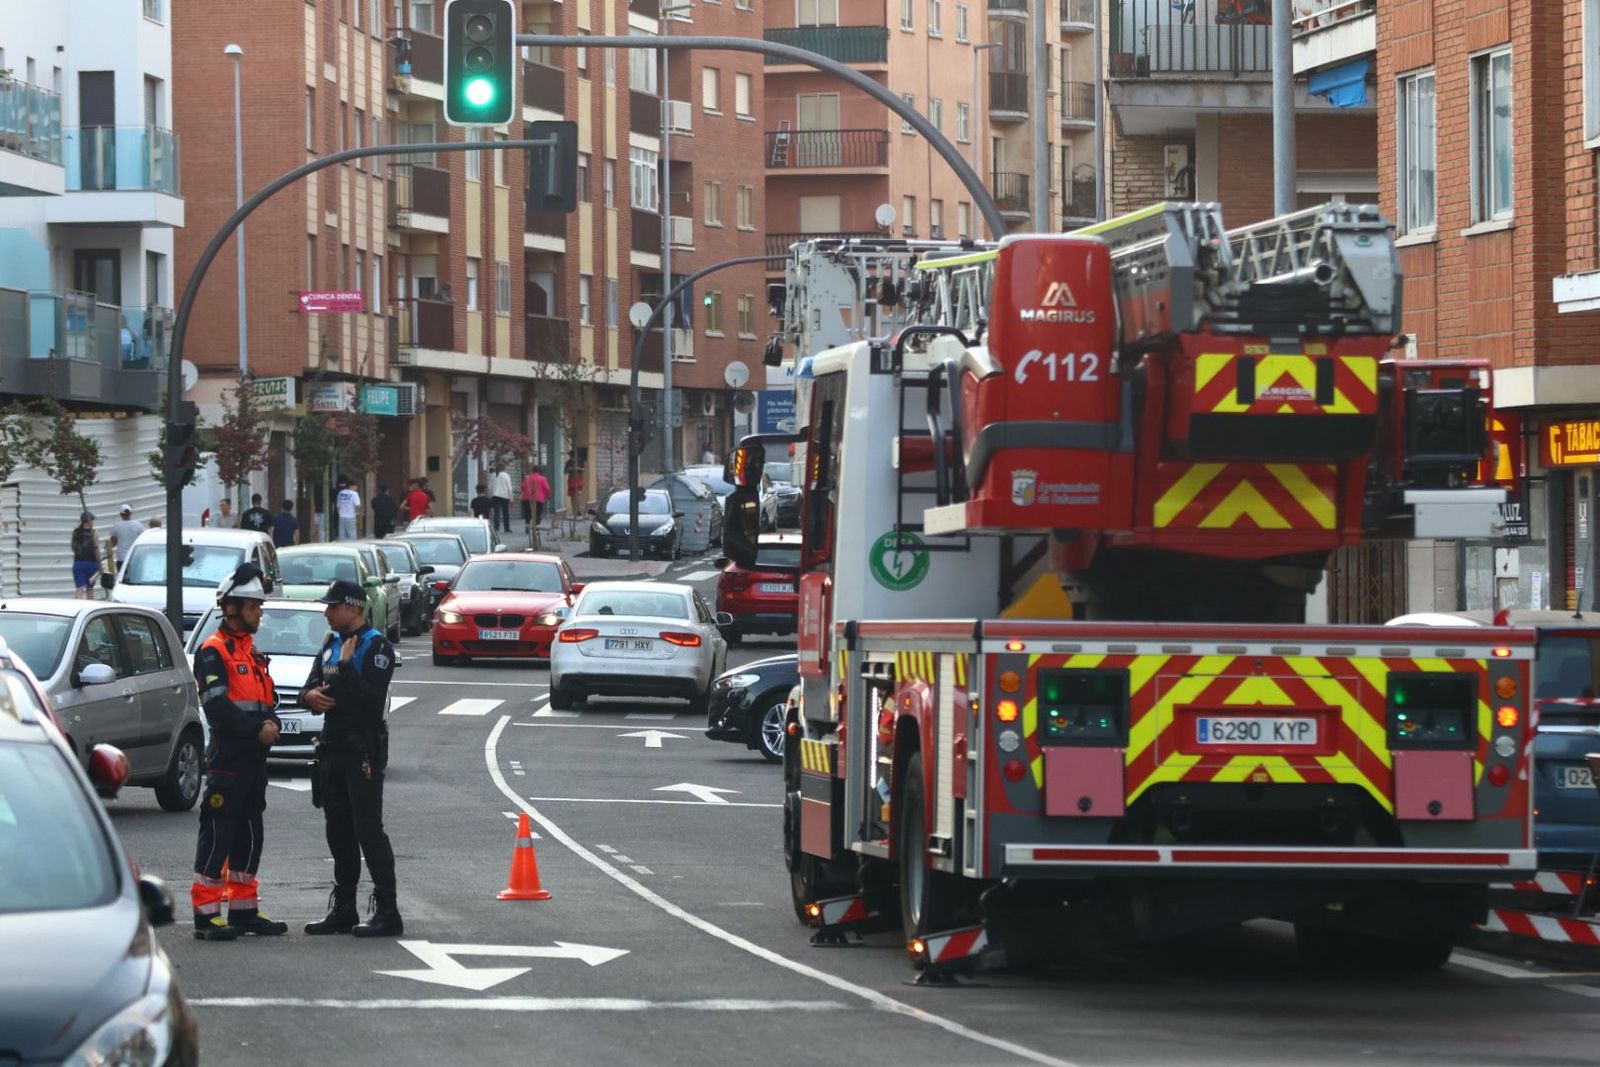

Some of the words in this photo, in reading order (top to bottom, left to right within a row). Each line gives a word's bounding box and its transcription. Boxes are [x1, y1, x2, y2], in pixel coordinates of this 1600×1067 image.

[337, 293, 361, 301] DENTAL
[1020, 308, 1096, 323] MAGIRUS
[1042, 352, 1099, 382] 112
[254, 381, 287, 395] FRUTAS
[366, 388, 389, 405] FELIPE
[609, 640, 629, 649] 7791
[634, 640, 650, 649] HXY
[1212, 721, 1261, 741] 6290
[1273, 721, 1310, 741] KYP
